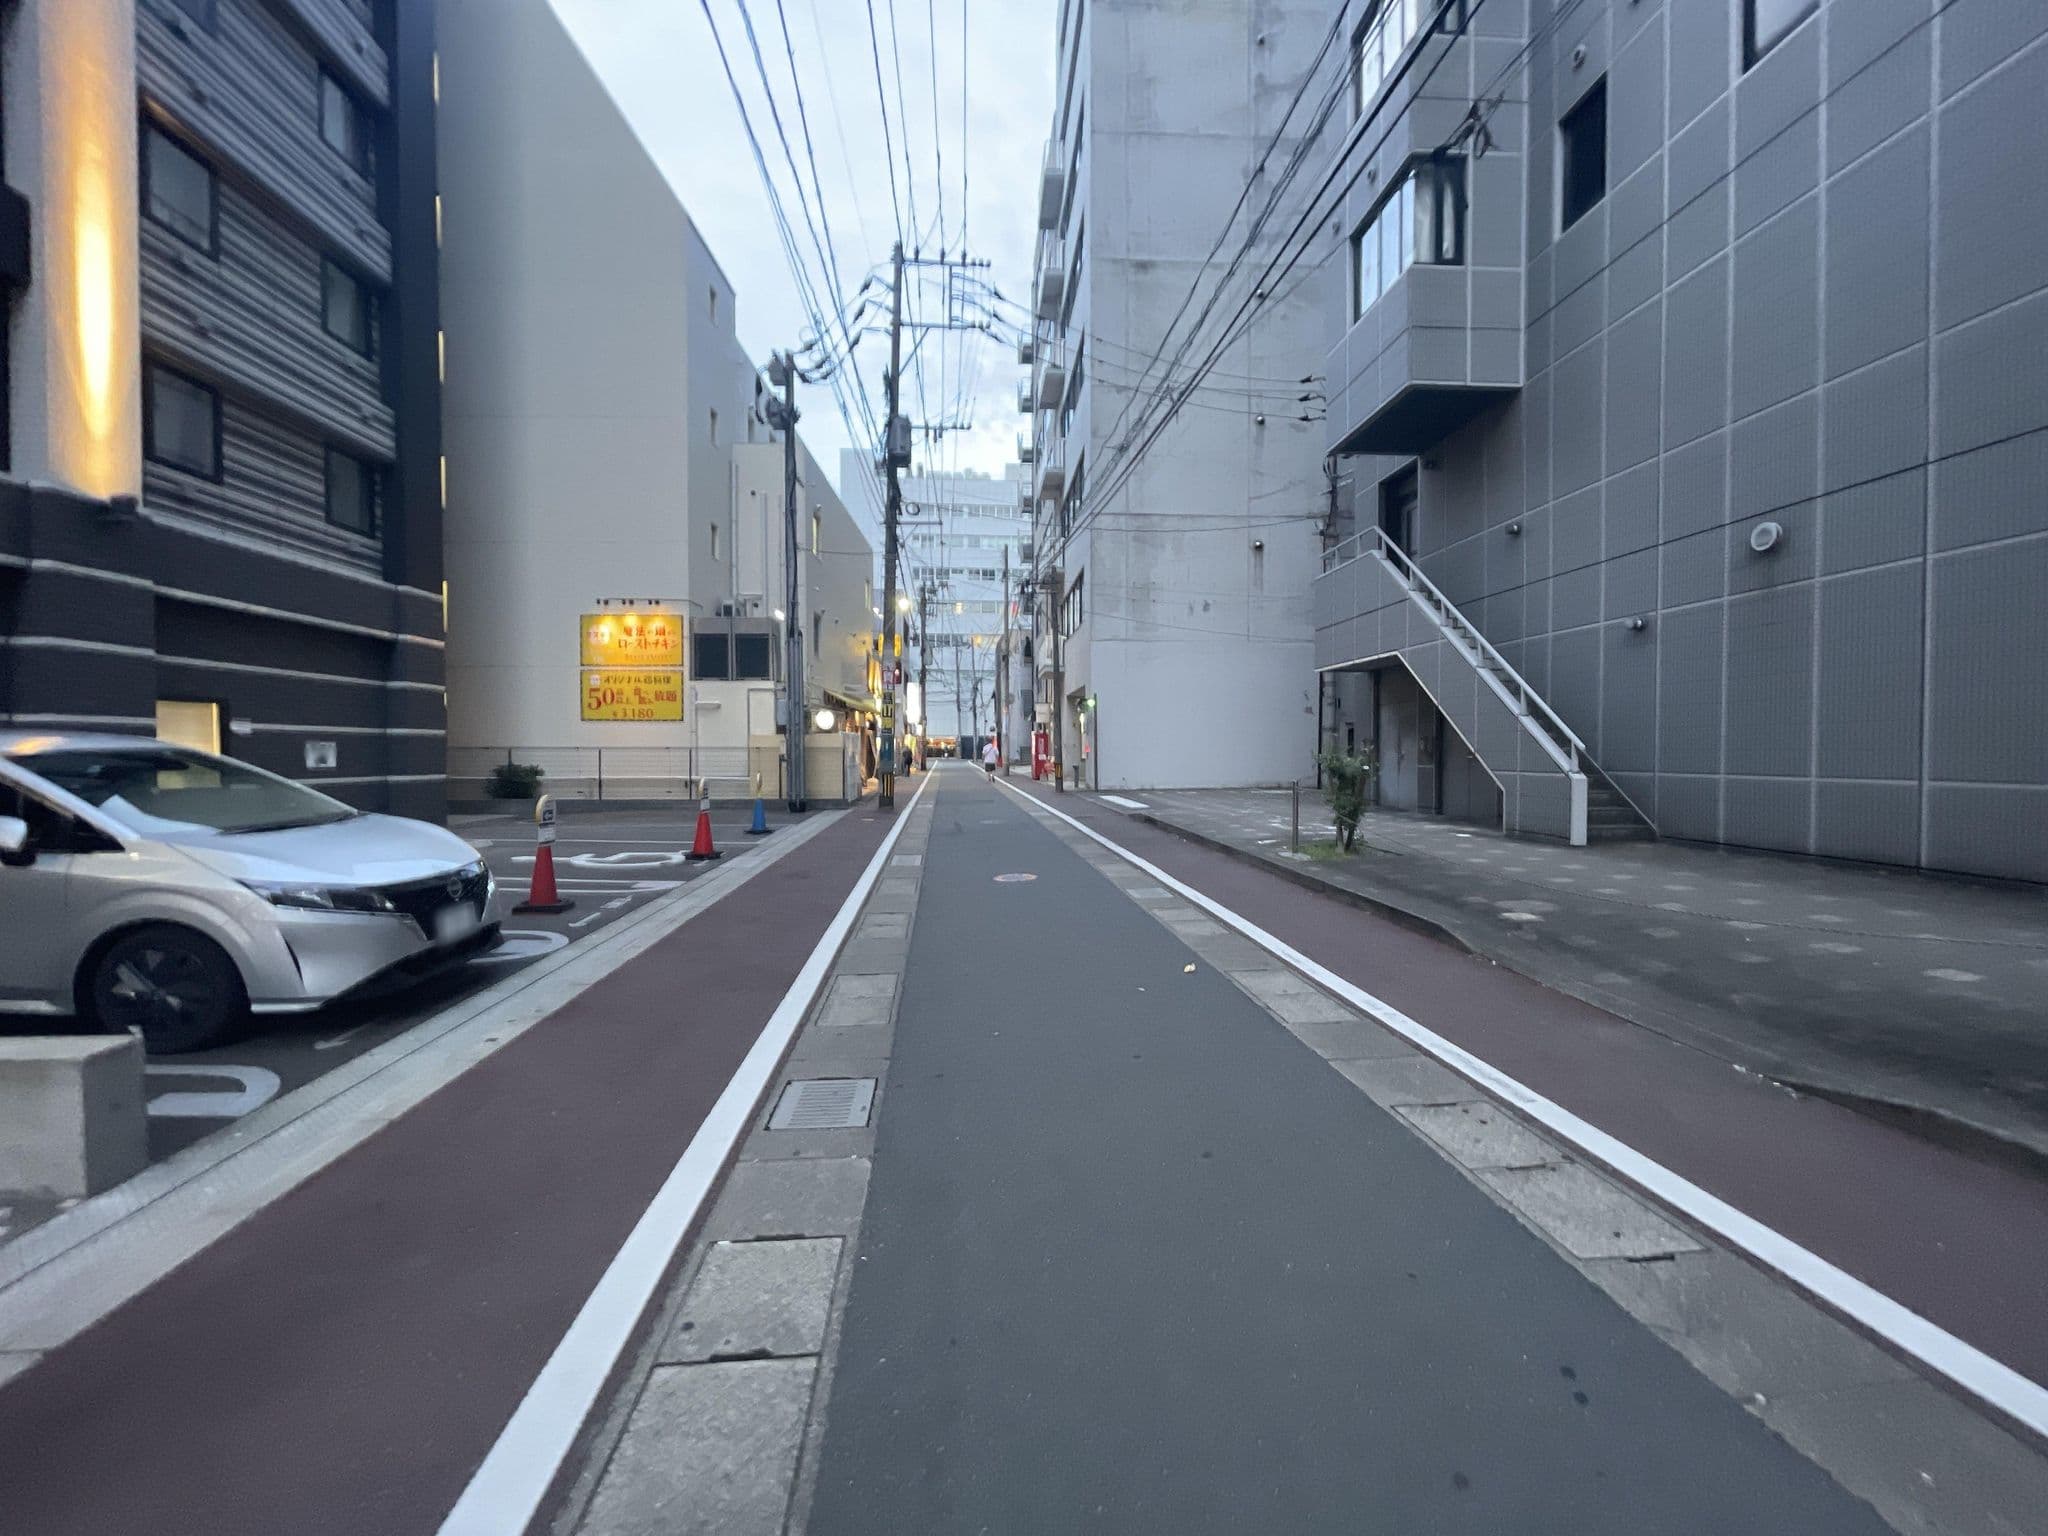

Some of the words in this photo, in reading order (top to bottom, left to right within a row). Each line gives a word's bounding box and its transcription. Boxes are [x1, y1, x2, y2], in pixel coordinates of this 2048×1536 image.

[618, 638, 680, 650] ローストチキン
[588, 688, 614, 709] 50
